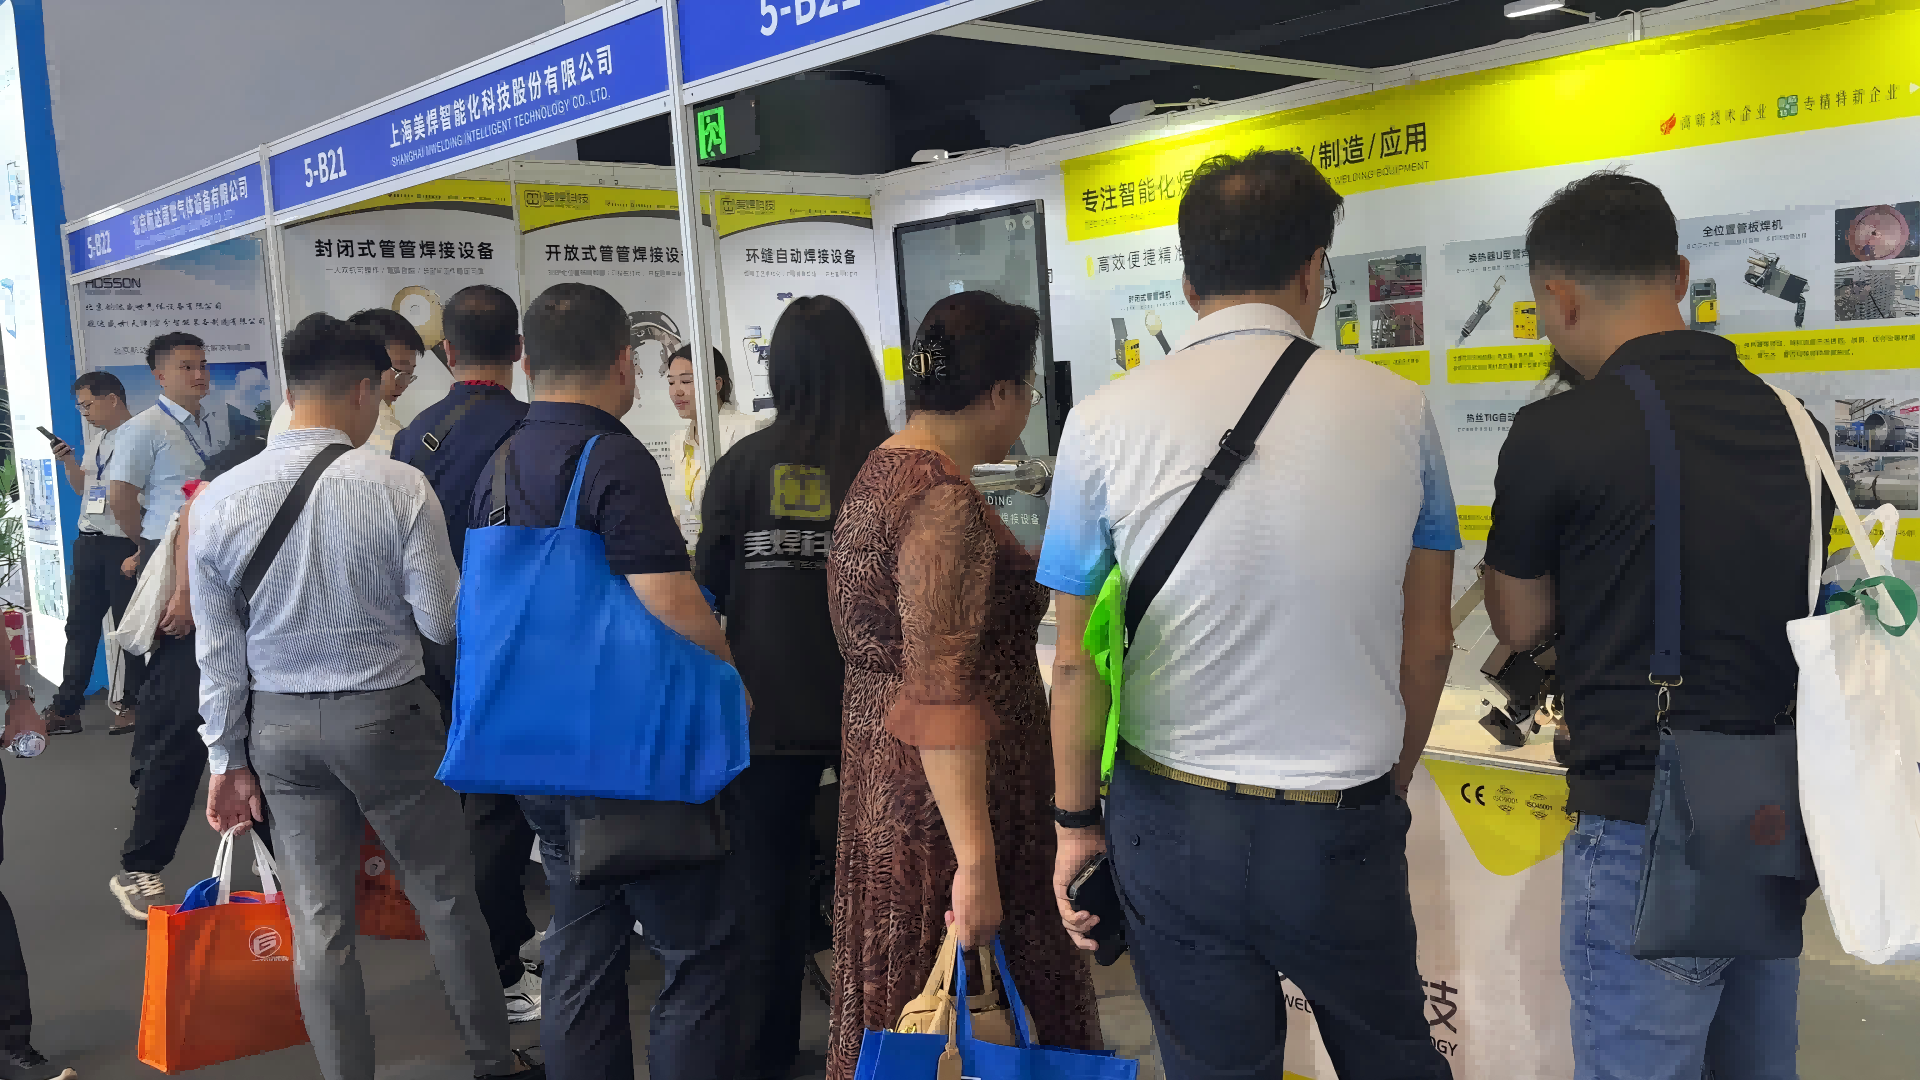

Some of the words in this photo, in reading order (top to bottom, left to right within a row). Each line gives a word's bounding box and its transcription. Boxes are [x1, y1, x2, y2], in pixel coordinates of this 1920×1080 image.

[389, 45, 613, 149] 上海美焊智能化科技股份有限公司
[1804, 83, 1898, 111] 专精特新企业
[391, 148, 425, 167] SHANGHAI
[464, 118, 512, 145] INTELLIGENT
[513, 101, 570, 128] TECHNOLOGY
[304, 146, 347, 188] 5-B21
[1702, 219, 1783, 238] 全位置管板焊机
[314, 238, 494, 260] 封闭式管管焊接设备
[545, 243, 684, 263] 开放式管管焊接设
[745, 248, 856, 265] 环缝自动焊接设备
[1460, 782, 1486, 807] CE
